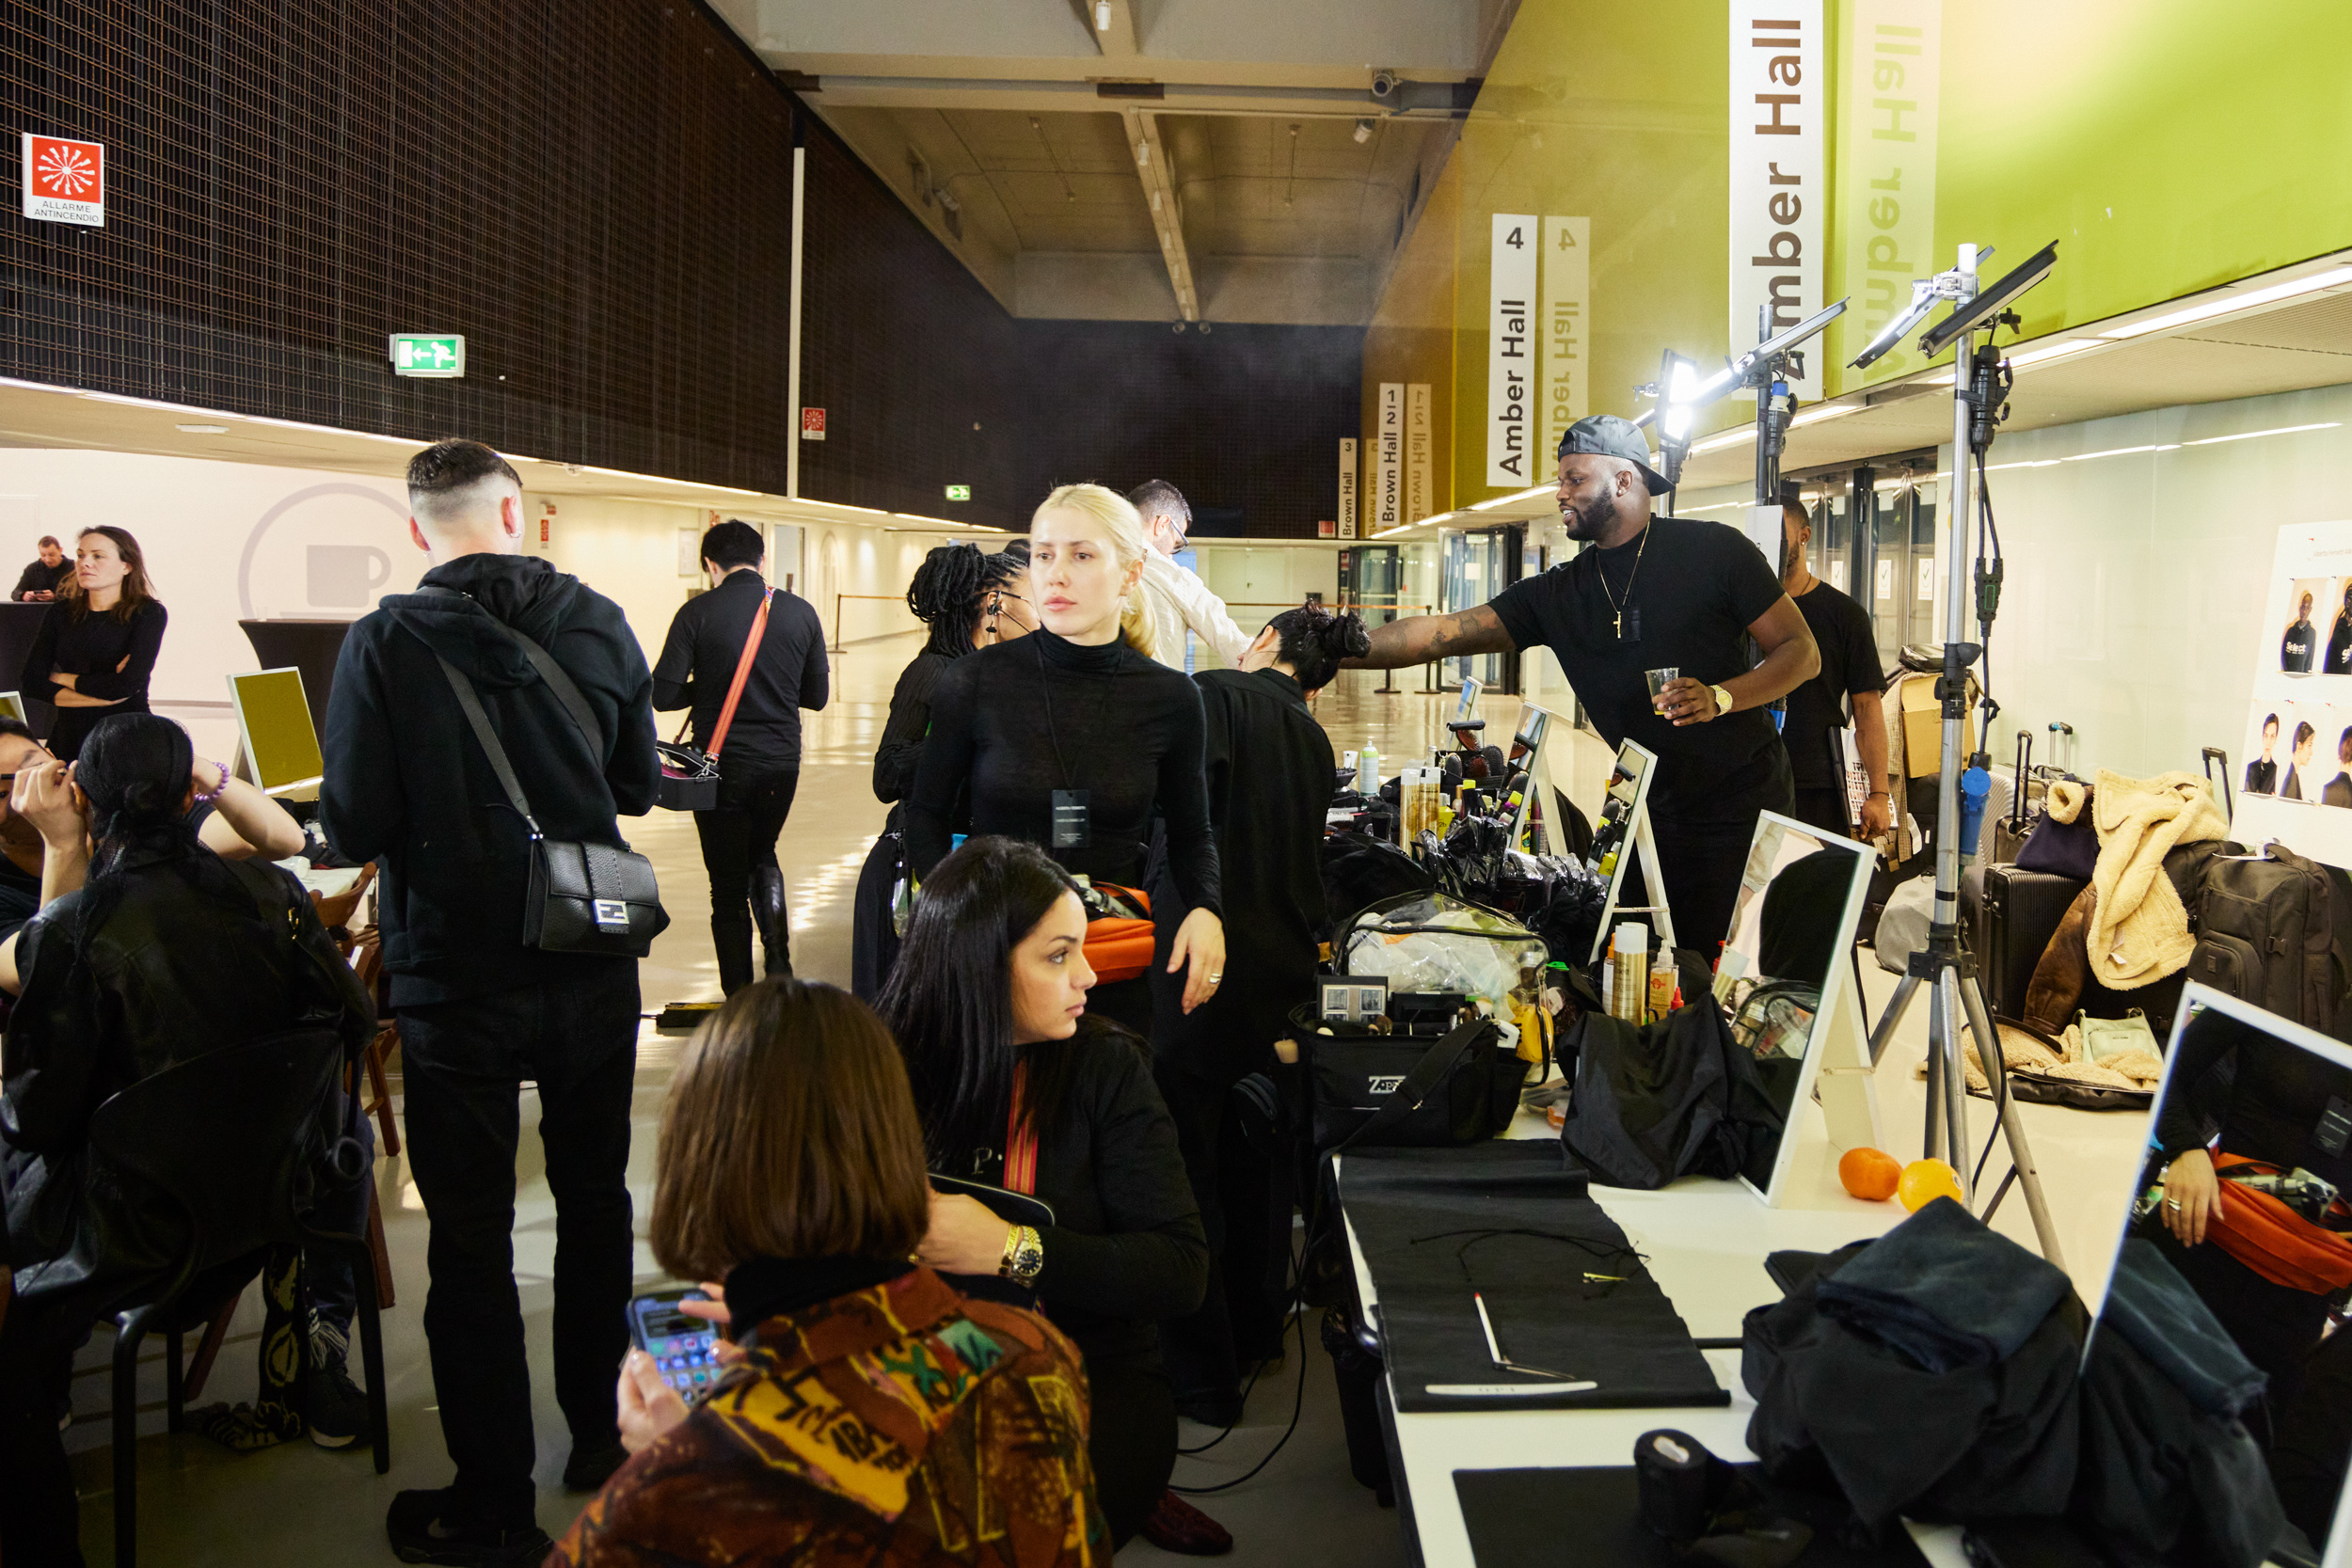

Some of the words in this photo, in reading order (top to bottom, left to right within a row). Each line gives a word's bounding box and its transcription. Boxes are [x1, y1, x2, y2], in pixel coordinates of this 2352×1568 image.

[1752, 20, 1802, 135] Hall
[34, 208, 100, 223] ANTINCENDIO
[42, 200, 91, 213] ALLARME
[1505, 227, 1524, 249] 4
[1501, 300, 1525, 357] Hall
[1499, 370, 1524, 477] Amber
[1344, 442, 1352, 451] 3
[1384, 432, 1397, 463] Hall
[1343, 472, 1353, 495] Hall
[1382, 469, 1396, 522] Brown
[1343, 499, 1352, 536] Brown
